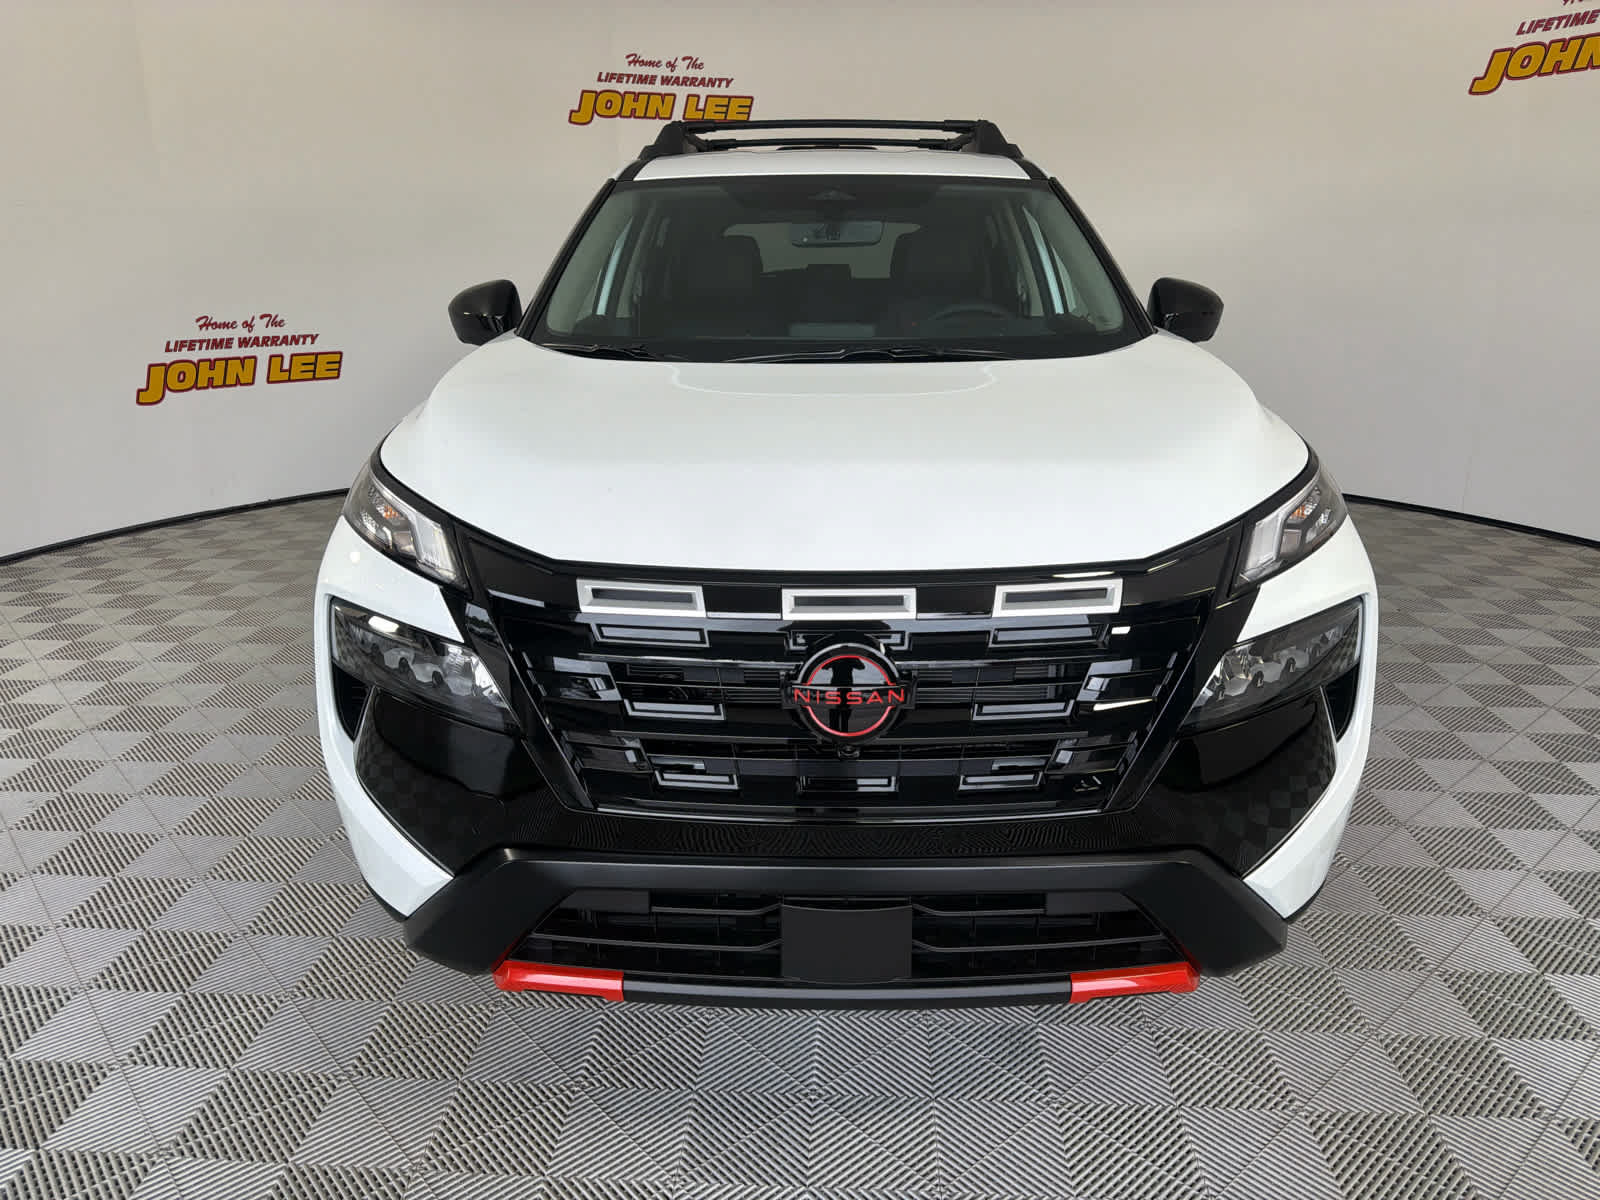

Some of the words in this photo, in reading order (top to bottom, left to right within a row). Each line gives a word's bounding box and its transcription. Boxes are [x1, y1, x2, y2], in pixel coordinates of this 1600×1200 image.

[1516, 9, 1600, 36] LIFETIME
[625, 53, 663, 68] Home
[665, 57, 678, 72] of
[682, 56, 705, 70] The
[597, 72, 657, 86] LIFETIME
[660, 75, 734, 88] WARRANTY
[568, 89, 676, 126] JOHN
[682, 94, 754, 122] LEE
[195, 315, 238, 331] Home
[241, 316, 255, 333] of
[259, 313, 285, 329] The
[164, 337, 234, 353] LIFETIME
[237, 333, 320, 349] WARRANTY
[136, 355, 257, 406] JOHN
[266, 351, 343, 384] LEE
[793, 688, 905, 705] NISSAN
